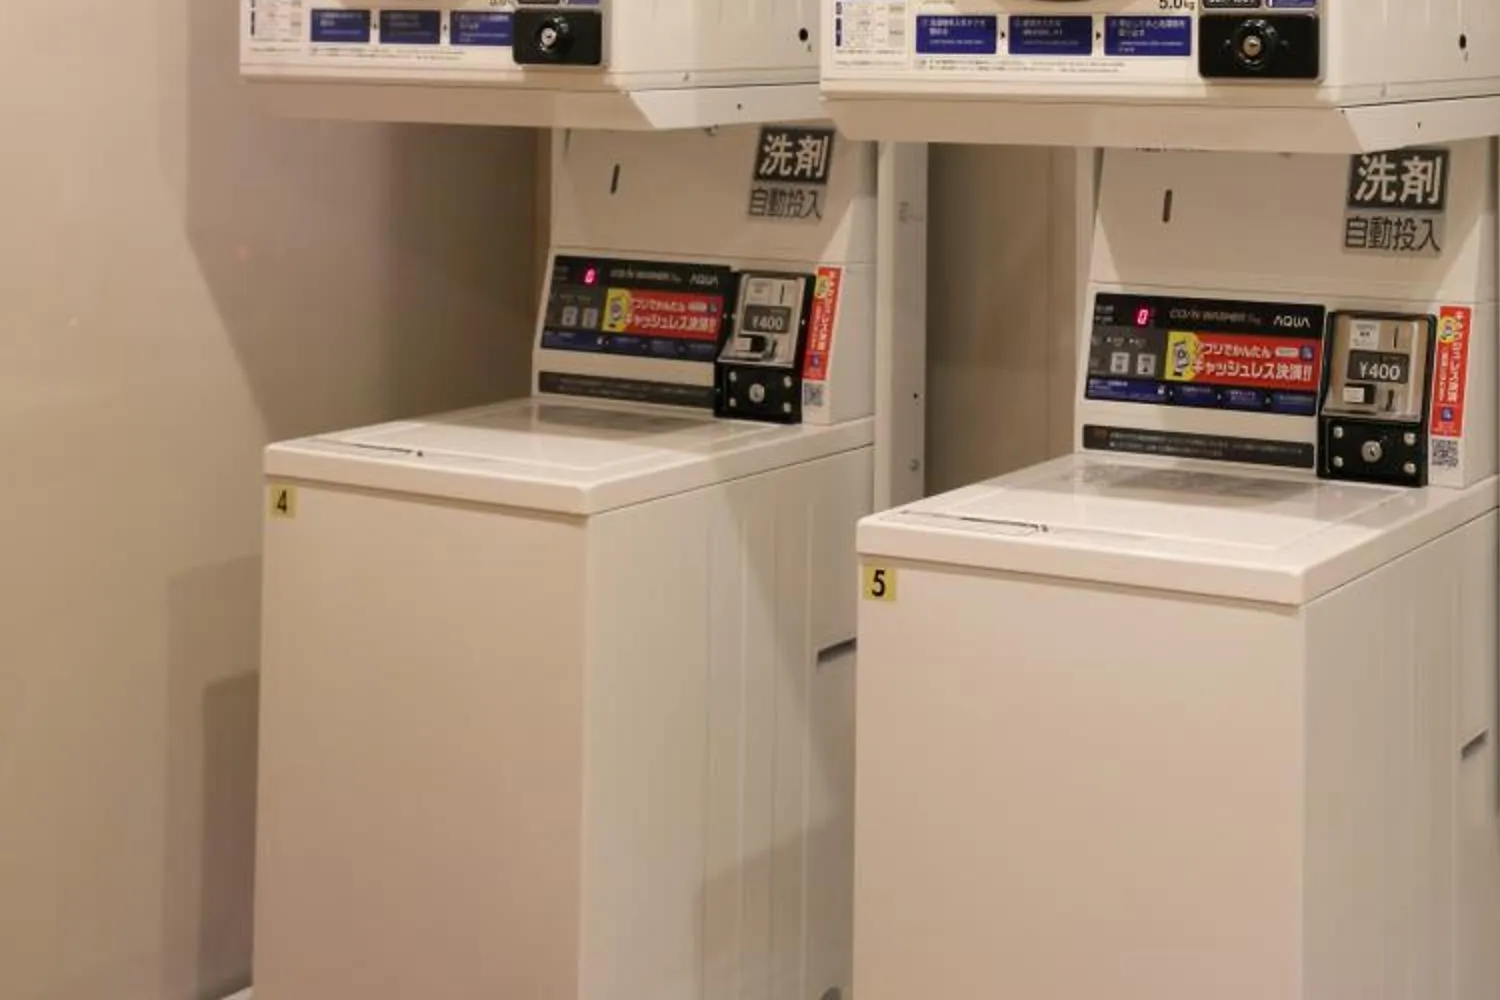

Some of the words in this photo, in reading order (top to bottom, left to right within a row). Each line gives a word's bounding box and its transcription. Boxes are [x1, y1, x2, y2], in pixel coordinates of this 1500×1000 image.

[758, 134, 831, 179] 洗剤
[1354, 154, 1442, 206] 洗剤
[748, 187, 823, 220] 自動投入
[1345, 214, 1441, 253] 自動投入
[1137, 309, 1149, 325] 0
[1273, 315, 1311, 329] AQUA
[1359, 361, 1401, 380] ¥400
[277, 488, 288, 514] 4
[871, 569, 887, 598] 5
